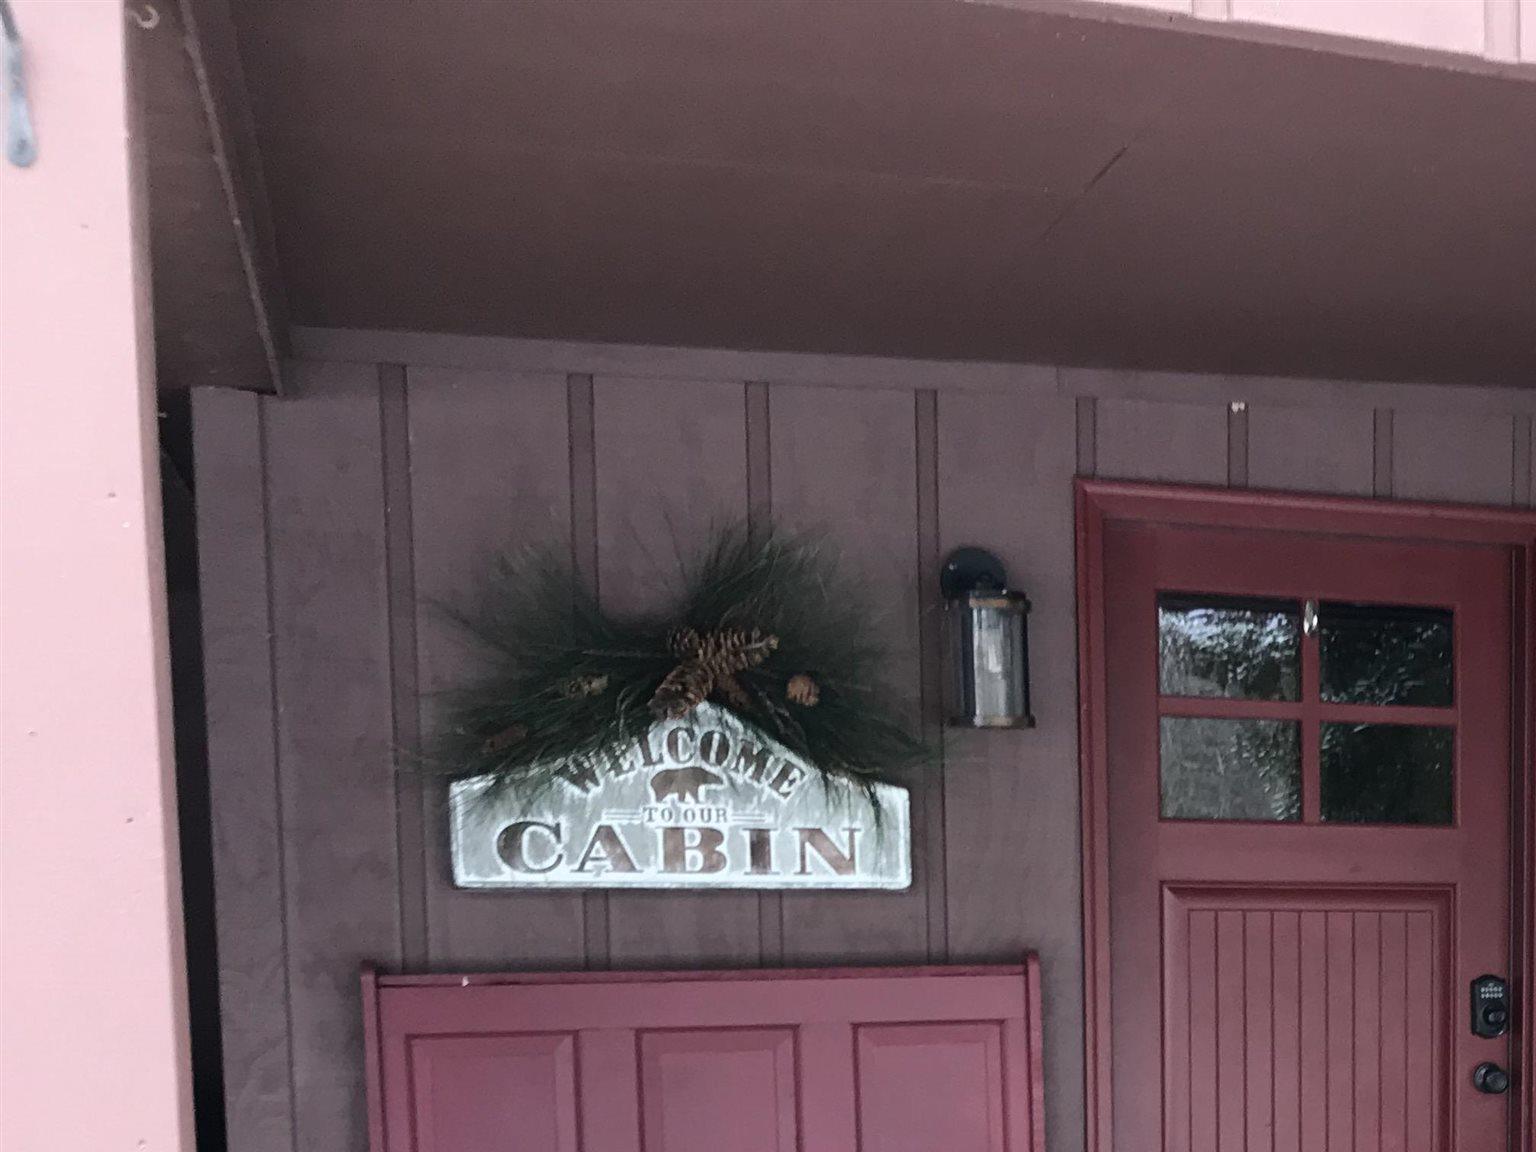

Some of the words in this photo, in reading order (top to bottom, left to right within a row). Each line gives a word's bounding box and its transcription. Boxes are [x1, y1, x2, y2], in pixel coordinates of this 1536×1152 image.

[556, 726, 806, 799] WELCOME
[642, 807, 674, 823] TO
[683, 807, 728, 823] OUR
[496, 822, 861, 875] CABIN
